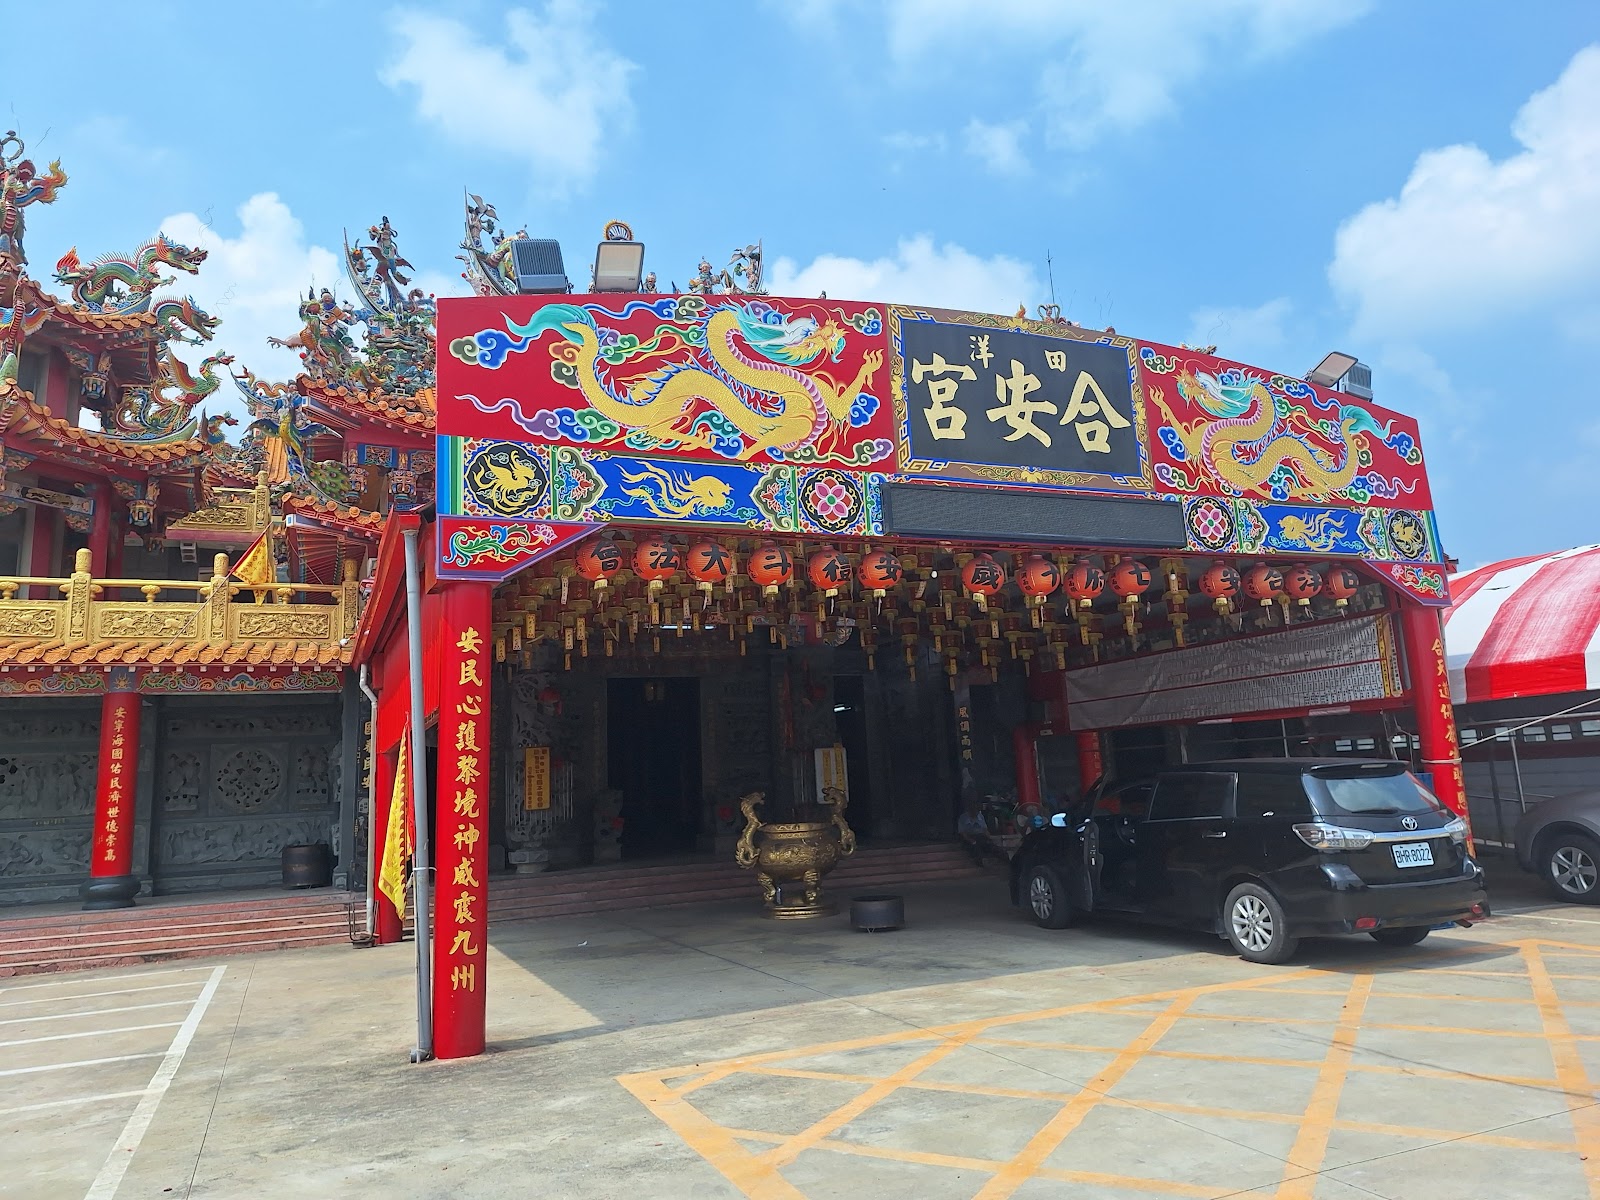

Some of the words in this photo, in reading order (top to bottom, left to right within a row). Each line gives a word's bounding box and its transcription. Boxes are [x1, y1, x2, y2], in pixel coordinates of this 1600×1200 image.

[591, 540, 622, 572] 會
[650, 542, 679, 571] 法
[700, 544, 729, 576] 大
[763, 547, 792, 576] 斗
[875, 553, 902, 582] 安
[971, 559, 1002, 590] 歲
